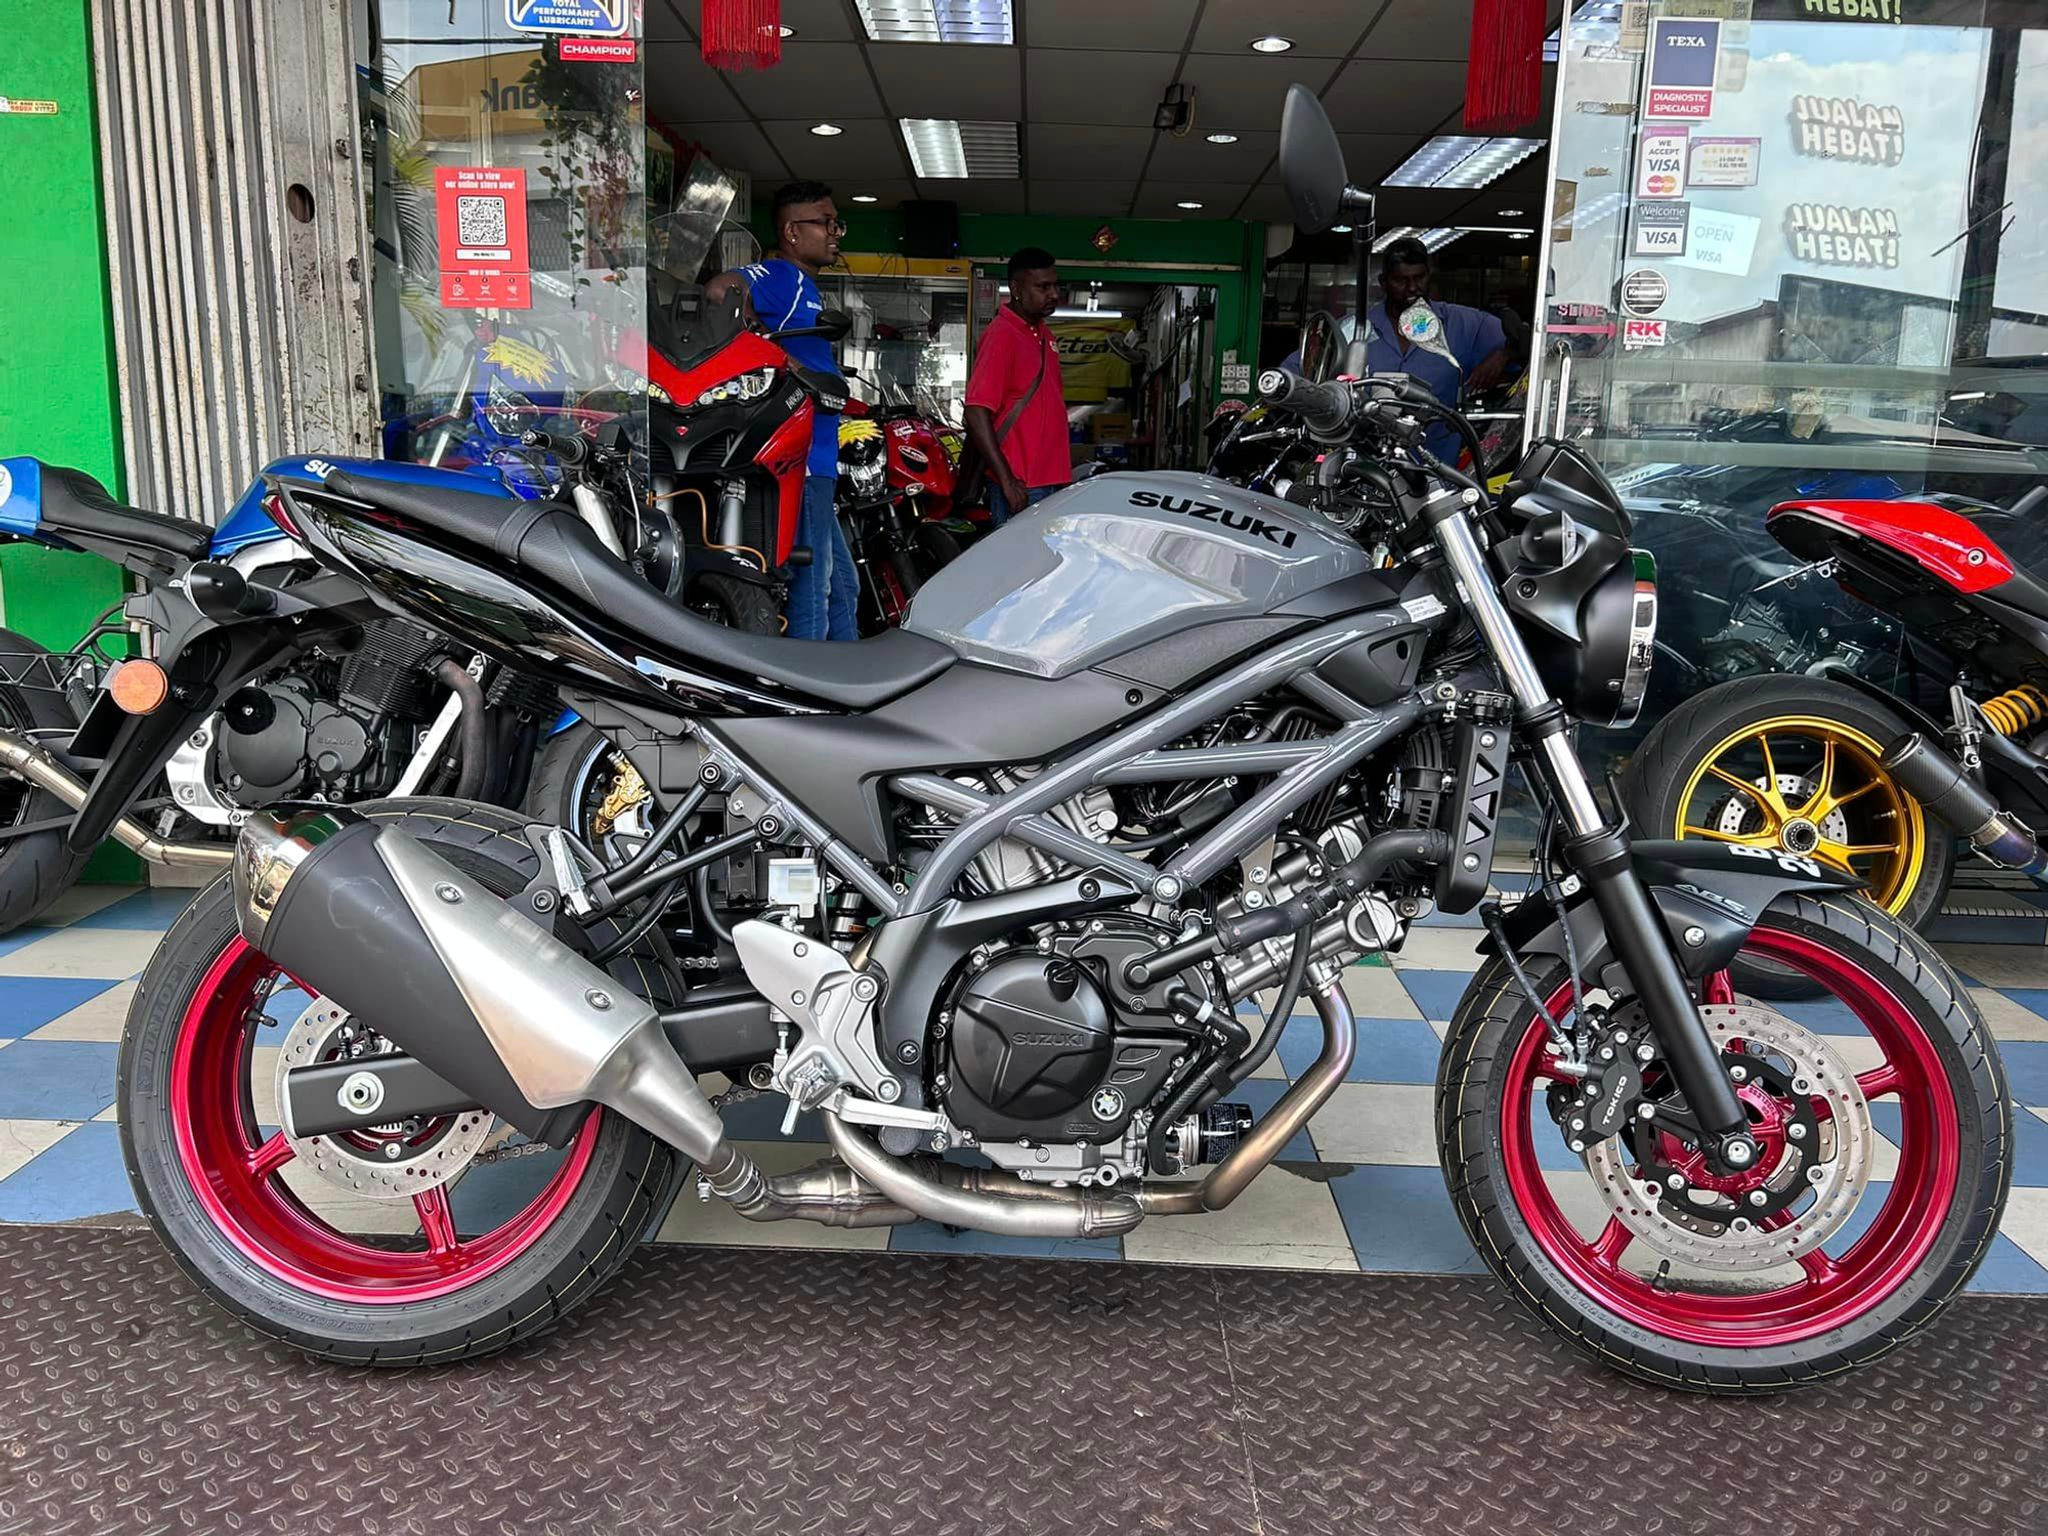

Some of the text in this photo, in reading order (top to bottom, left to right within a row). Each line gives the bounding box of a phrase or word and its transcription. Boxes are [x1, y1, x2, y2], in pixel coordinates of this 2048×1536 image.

[532, 7, 601, 18] PERFORMANCE
[1804, 0, 1901, 24] HEBAT!
[538, 16, 596, 26] LUBRICANTS
[1667, 36, 1707, 47] TEXA
[562, 45, 633, 56] CHAMPION
[1653, 93, 1708, 103] DIAGNOSTIC
[1653, 104, 1706, 113] SPECIALIST
[1797, 97, 1902, 132] JUALAN
[1802, 123, 1902, 162] HEBAT!
[1648, 148, 1680, 156] ACCEPT
[1648, 158, 1681, 172] VISA
[1640, 204, 1686, 217] Welcome
[1791, 205, 1897, 238] JUALAN
[1645, 231, 1677, 244] VISA
[1796, 232, 1897, 266] HEBAT!
[1557, 303, 1607, 318] SLIDE
[1627, 321, 1662, 336] RK
[1128, 491, 1298, 549] SUZUKI
[1012, 1032, 1085, 1047] SUZUKI
[1602, 1075, 1628, 1126] TOKICO
